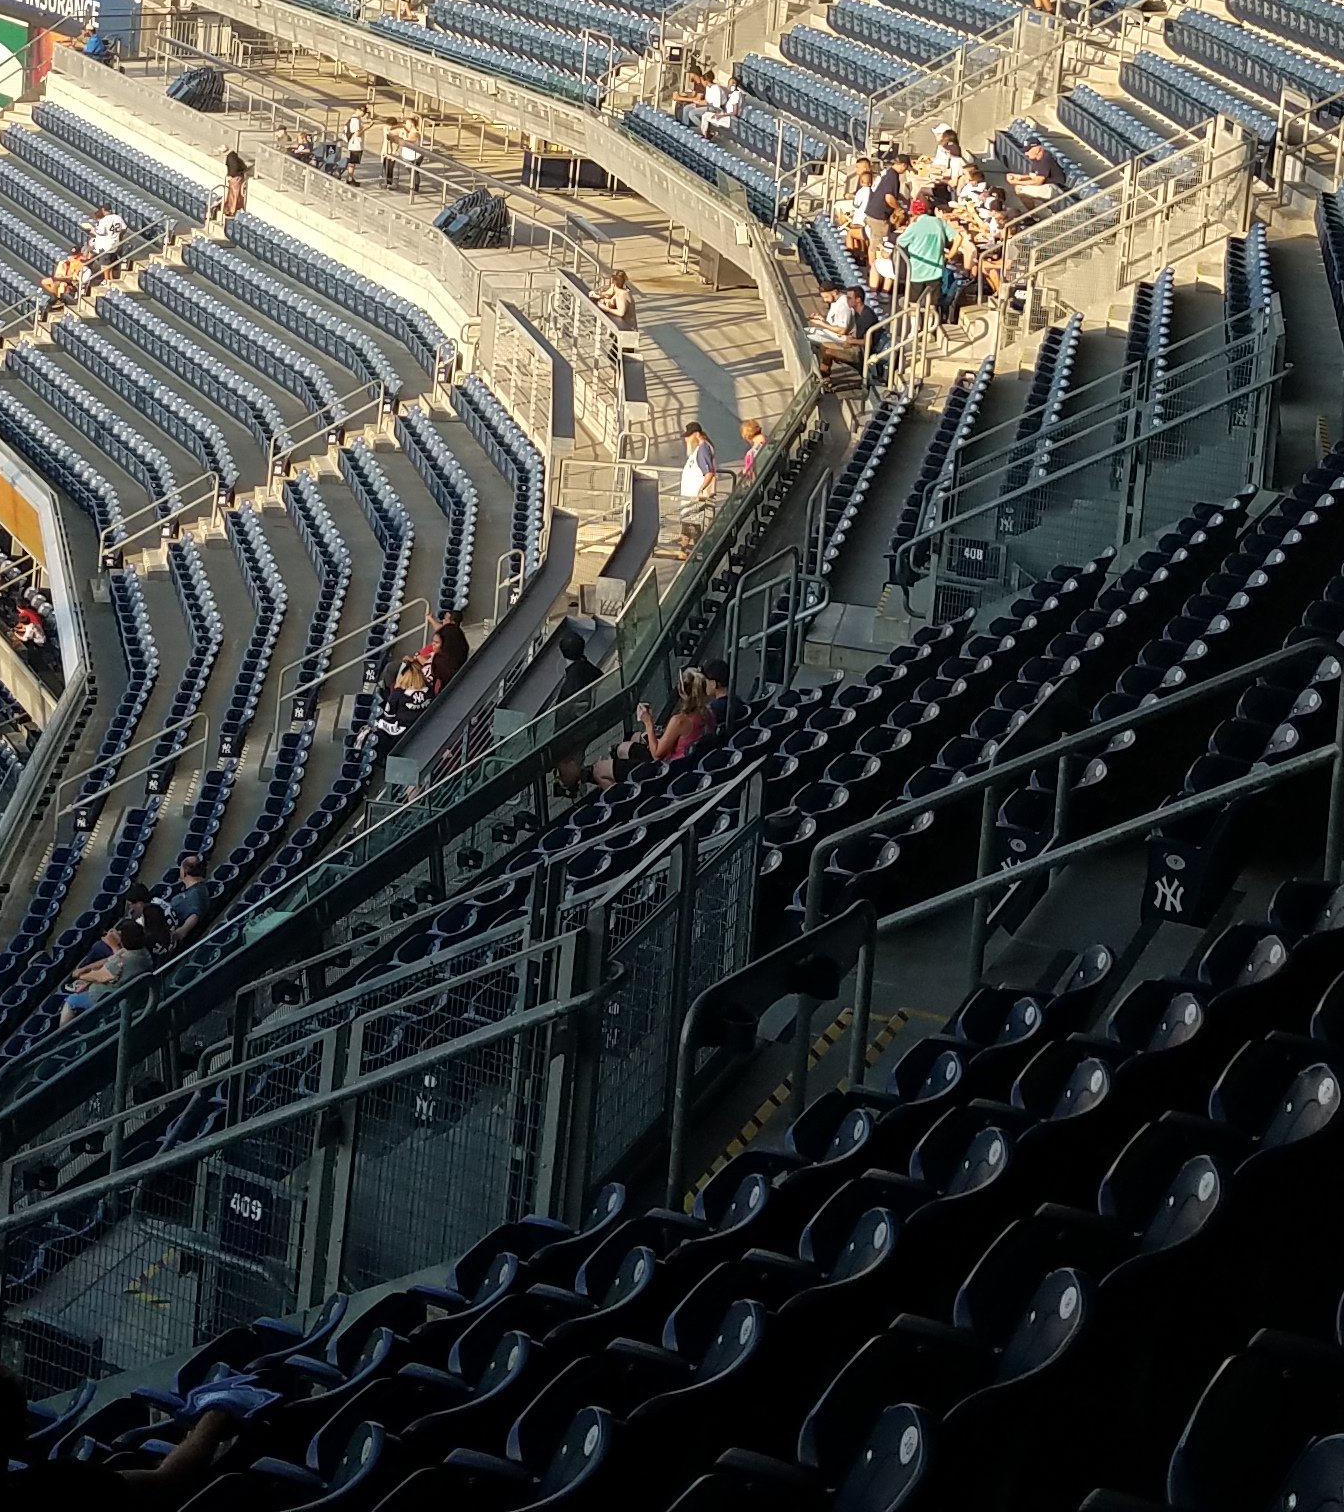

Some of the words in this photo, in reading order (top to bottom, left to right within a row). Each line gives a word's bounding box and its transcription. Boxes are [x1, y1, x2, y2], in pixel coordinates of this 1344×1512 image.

[109, 223, 122, 235] 42
[963, 547, 984, 561] 408
[230, 1192, 262, 1222] 409
